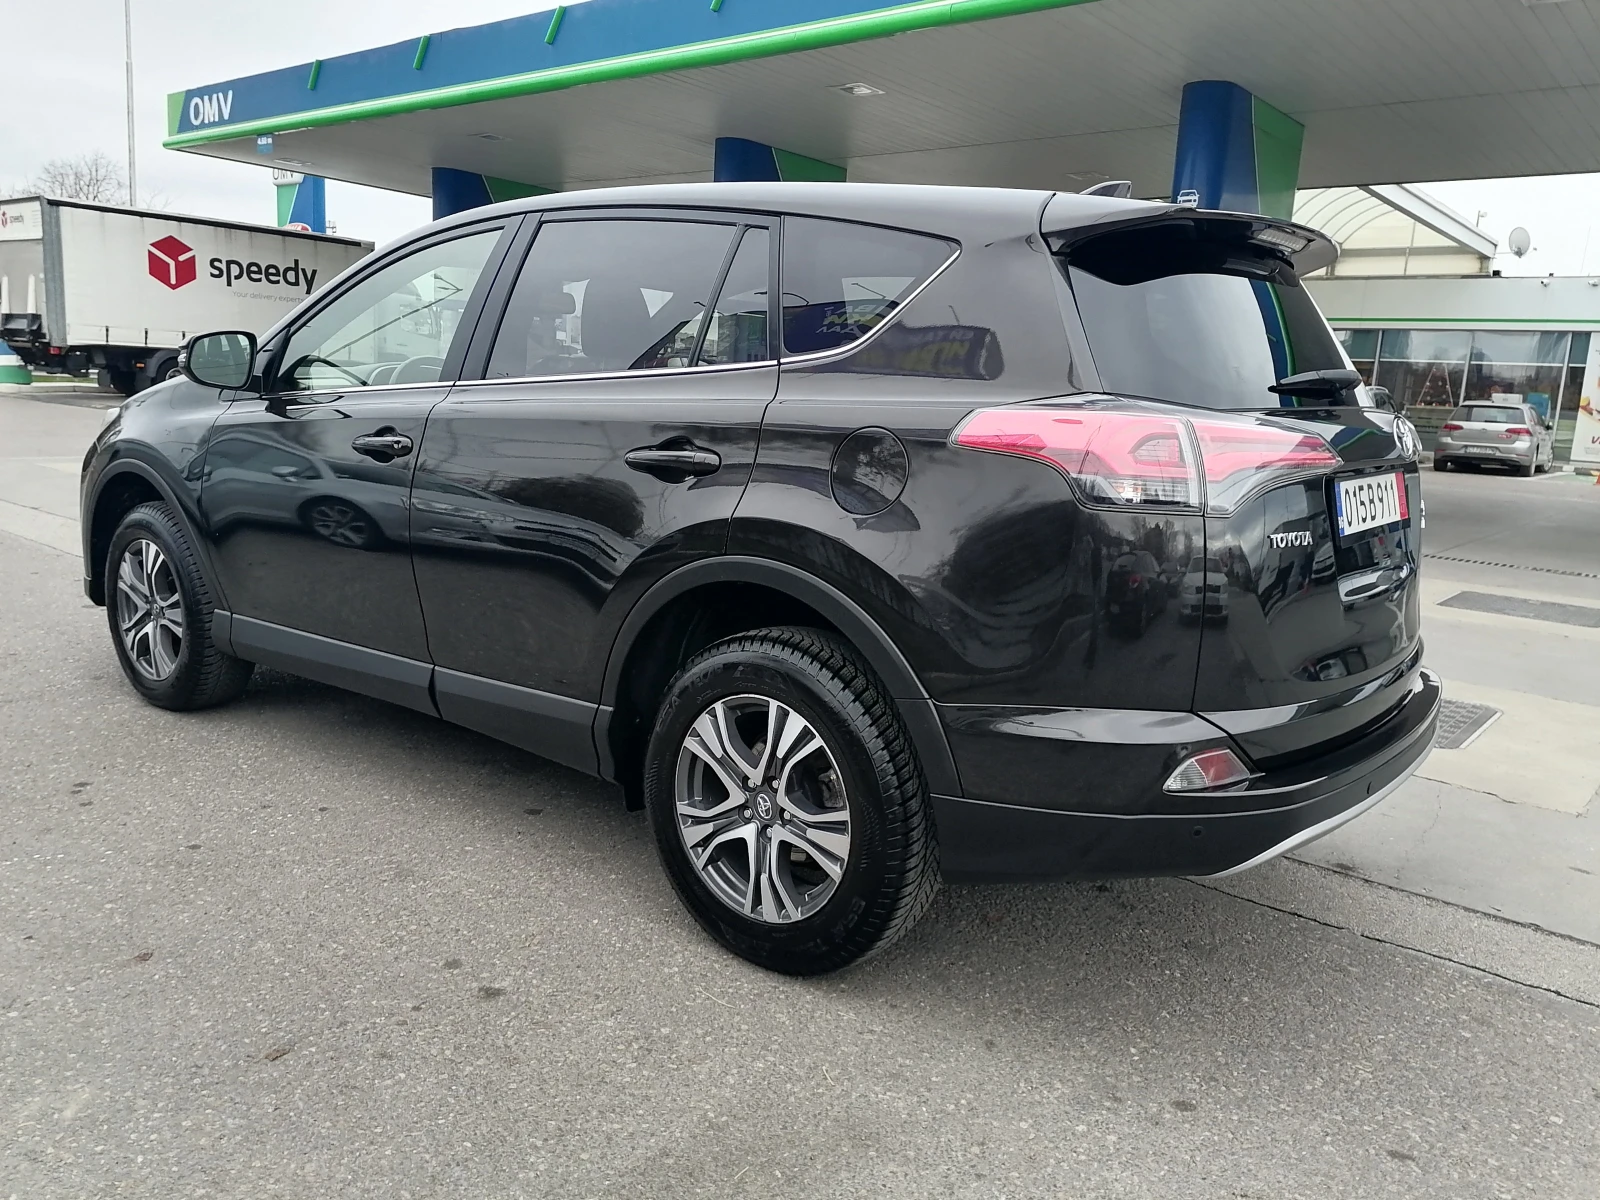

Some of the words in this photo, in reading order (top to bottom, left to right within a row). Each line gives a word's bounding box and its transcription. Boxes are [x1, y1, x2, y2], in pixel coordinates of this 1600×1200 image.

[189, 90, 233, 126] OMV
[209, 257, 318, 295] speedy
[232, 290, 249, 298] Your
[249, 291, 278, 302] delivery
[1344, 479, 1397, 528] 015B911
[1269, 531, 1314, 549] TOYOTA
